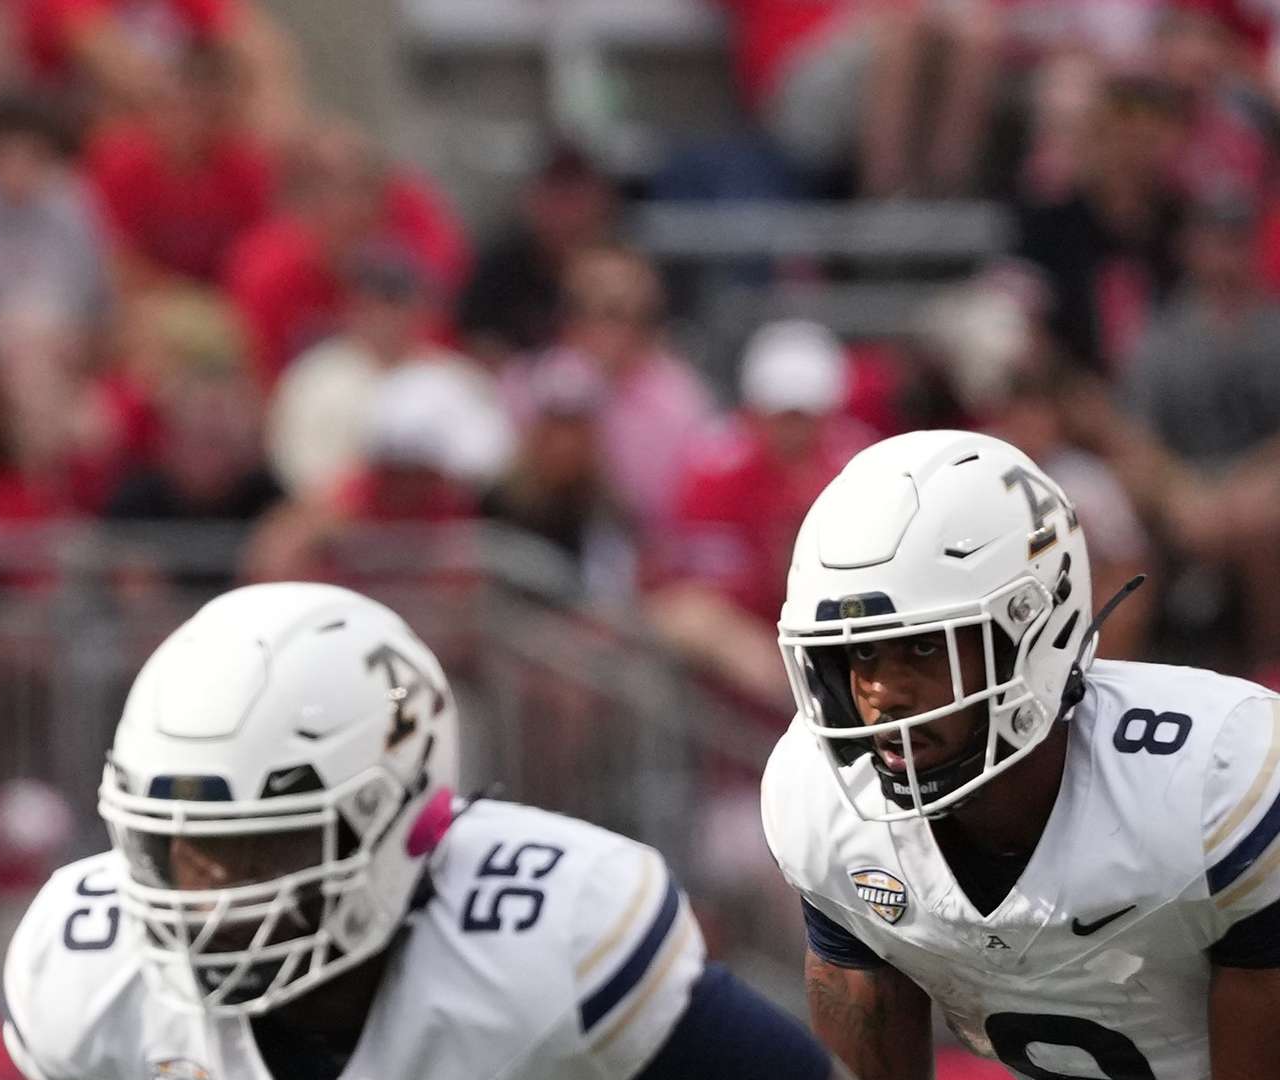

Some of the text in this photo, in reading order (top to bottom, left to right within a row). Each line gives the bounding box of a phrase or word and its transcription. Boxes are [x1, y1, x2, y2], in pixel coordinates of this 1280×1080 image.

[1000, 465, 1079, 560] A
[364, 644, 445, 752] A
[1114, 708, 1192, 755] 8
[893, 781, 938, 794] Ridell
[462, 842, 565, 934] 55
